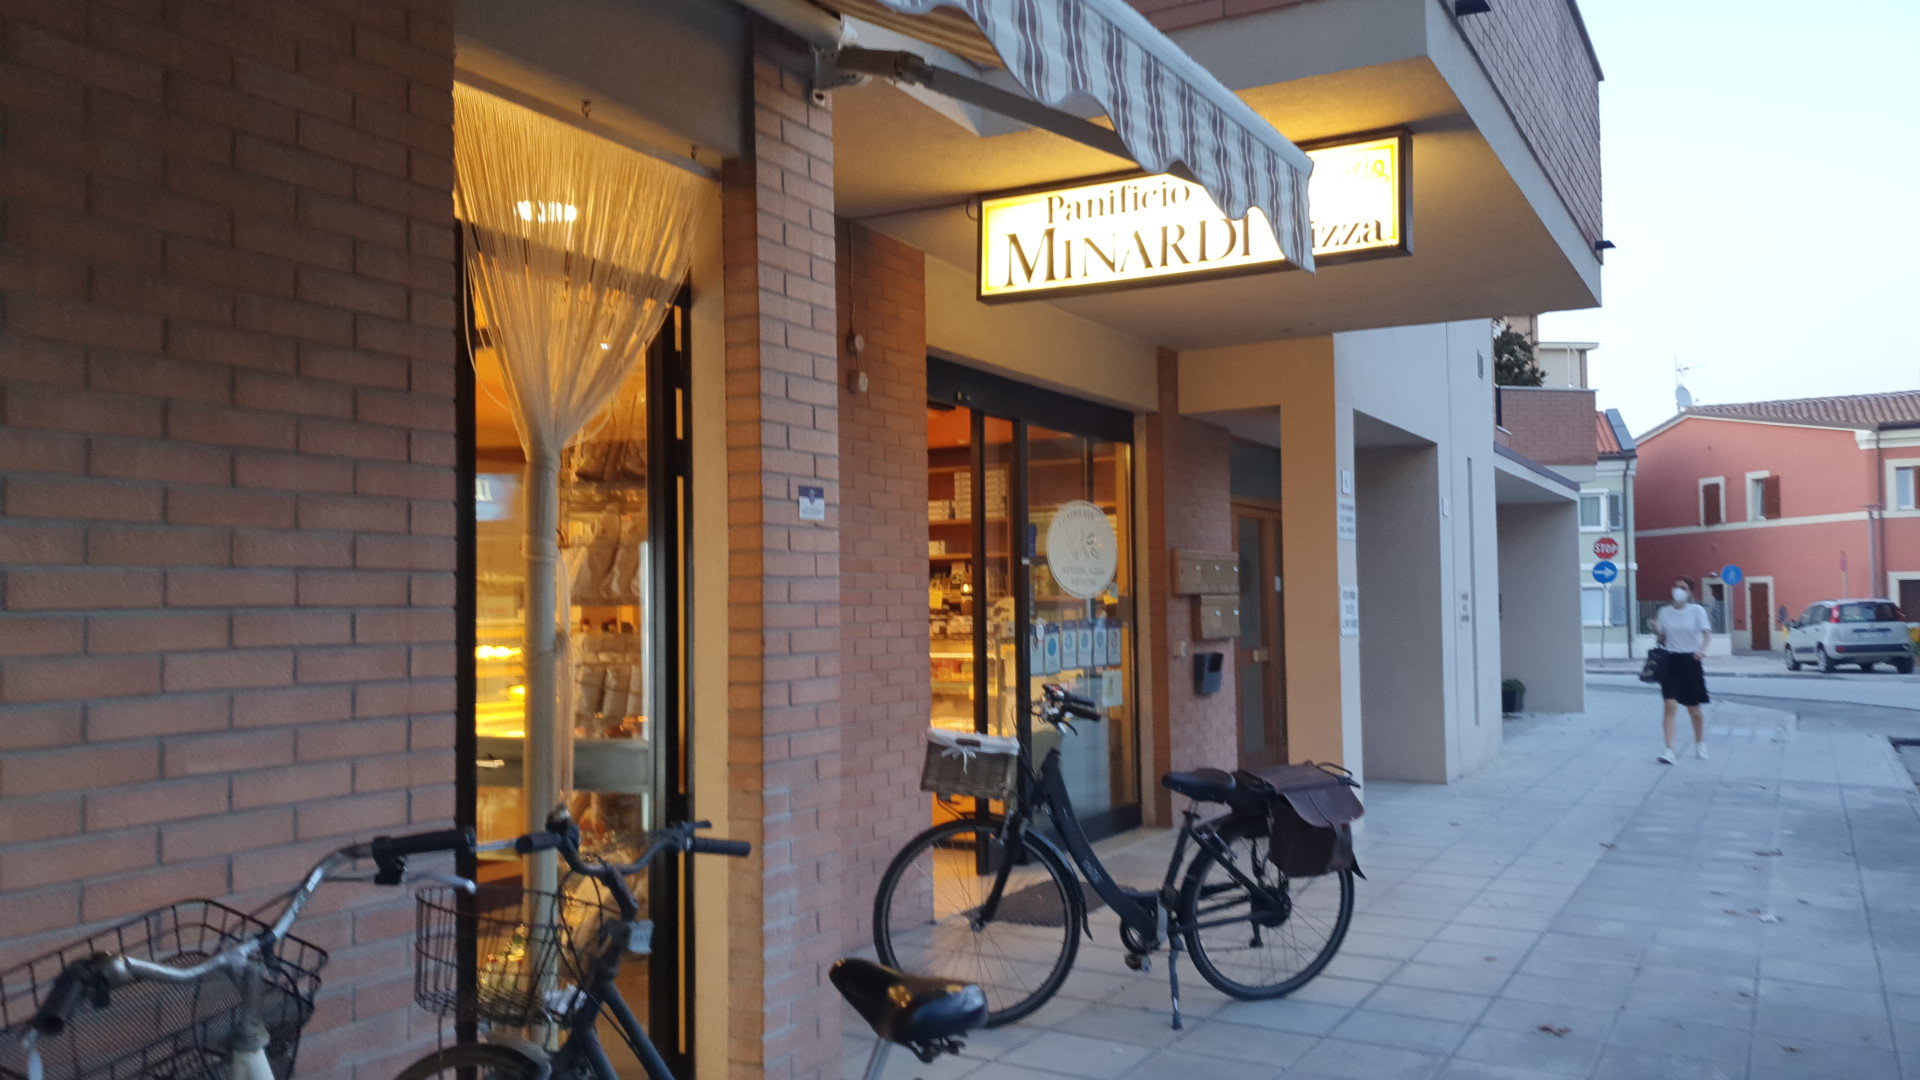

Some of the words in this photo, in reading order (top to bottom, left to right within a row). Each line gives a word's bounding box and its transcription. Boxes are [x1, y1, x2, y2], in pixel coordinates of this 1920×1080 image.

[1047, 180, 1191, 225] Panificio
[1003, 213, 1252, 288] MINARDI
[1309, 218, 1384, 250] izza
[1594, 543, 1618, 554] STOP
